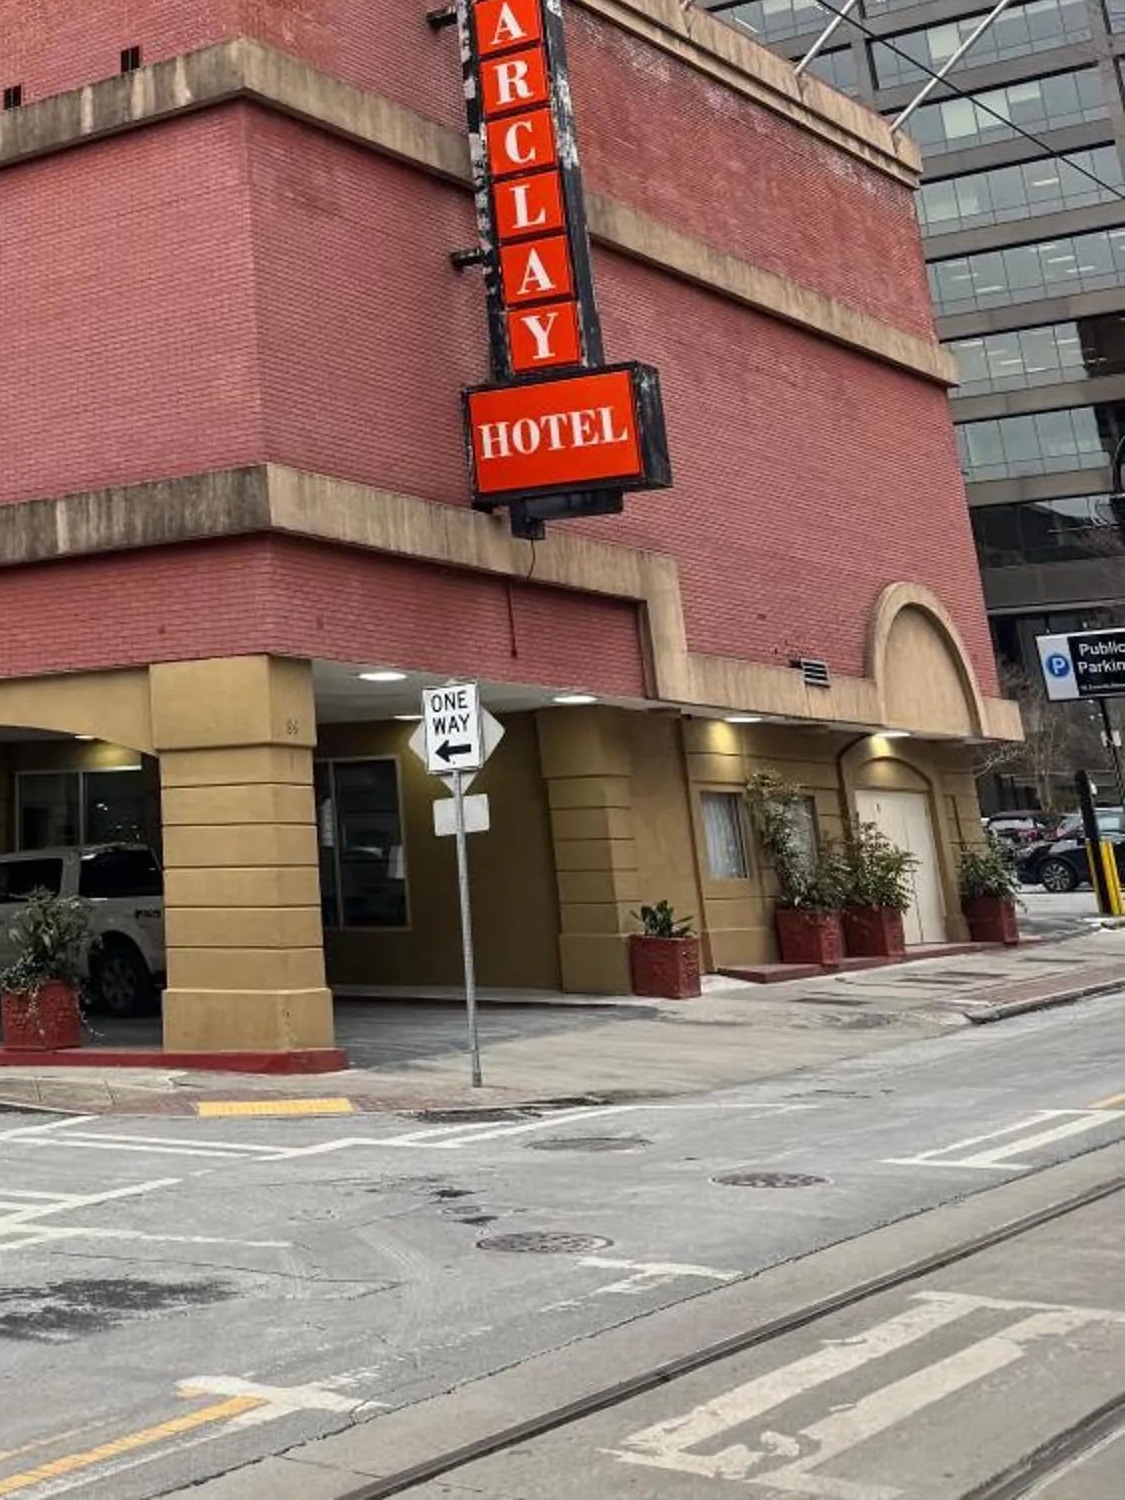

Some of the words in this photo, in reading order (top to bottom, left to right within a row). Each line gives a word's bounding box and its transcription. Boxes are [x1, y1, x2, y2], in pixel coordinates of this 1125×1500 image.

[477, 406, 628, 460] HOTEL
[1078, 659, 1125, 674] Parkin
[431, 690, 468, 713] ONE
[433, 713, 470, 735] WAY
